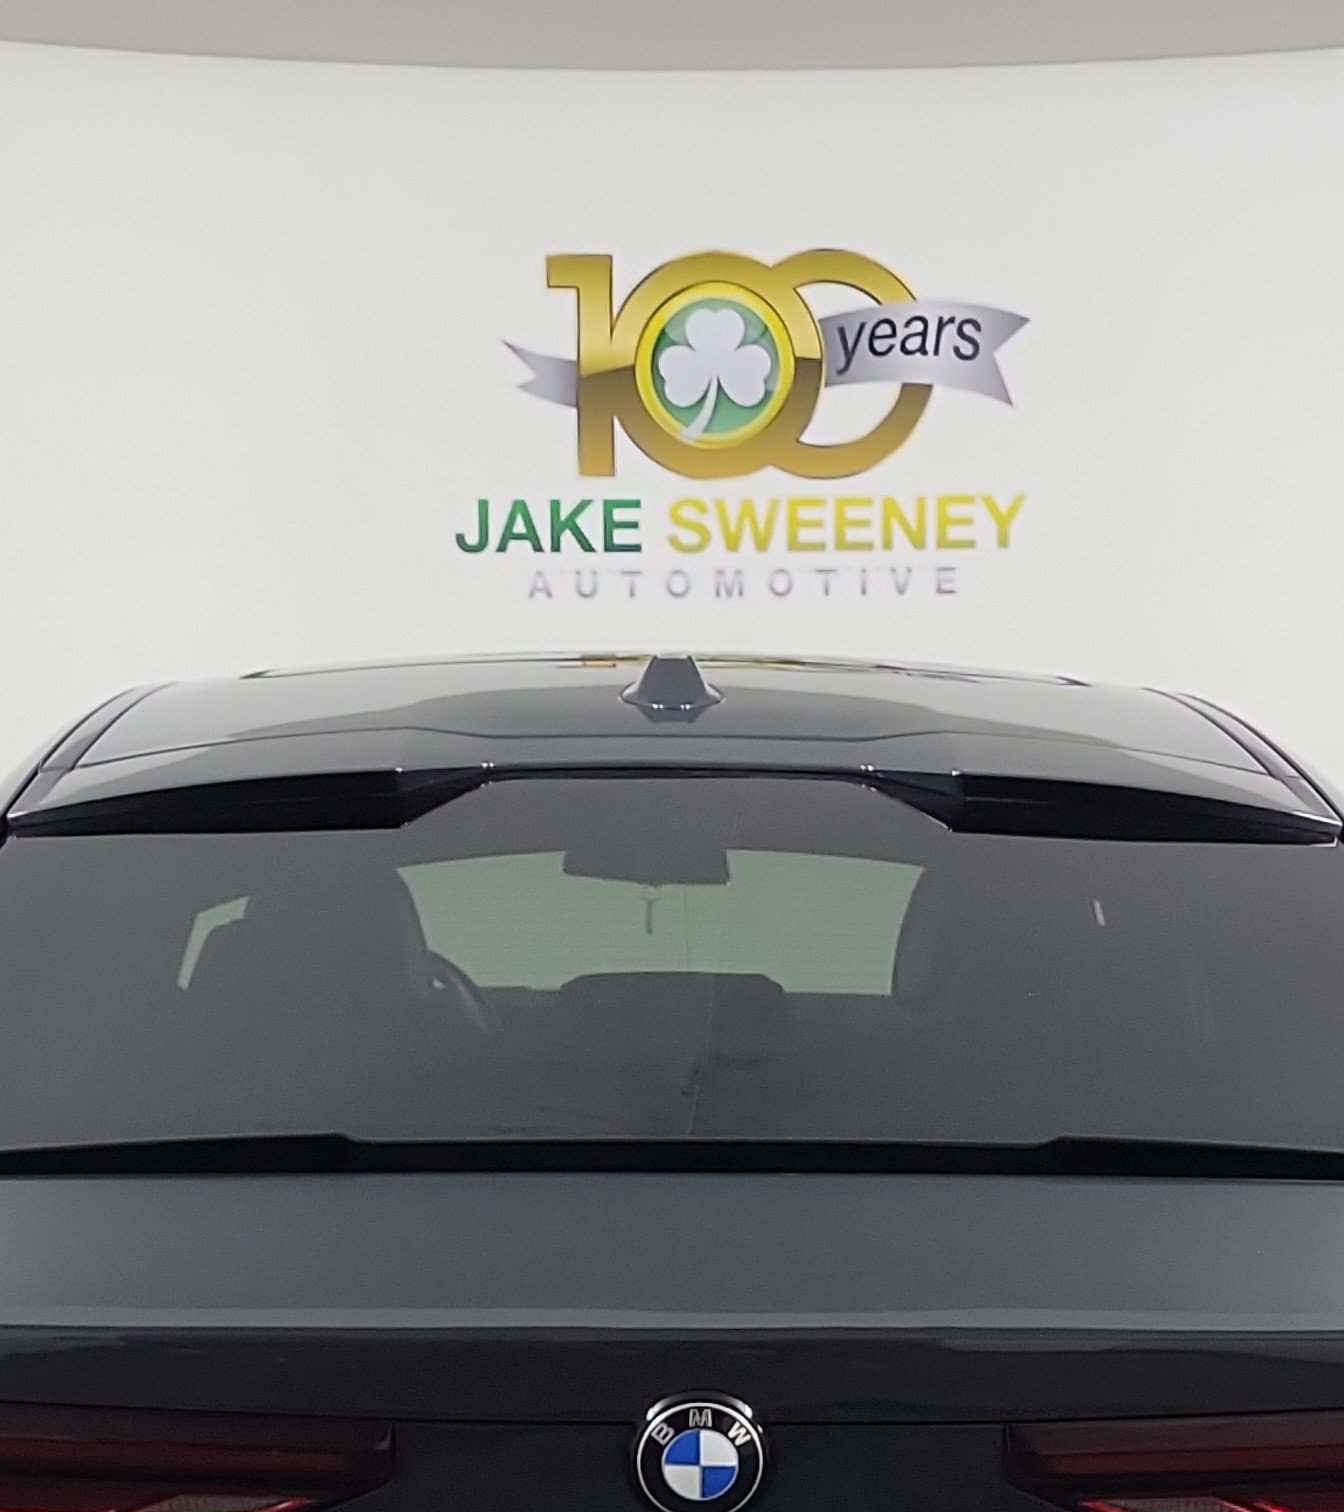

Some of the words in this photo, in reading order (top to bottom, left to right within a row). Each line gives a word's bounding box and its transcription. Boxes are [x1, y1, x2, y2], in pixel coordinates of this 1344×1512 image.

[545, 249, 933, 479] 100
[833, 314, 982, 376] years
[455, 498, 642, 554] JAKE
[667, 494, 1027, 552] SWEENEY
[528, 567, 958, 599] AUTOMOTIVE
[651, 1409, 751, 1447] BMW
